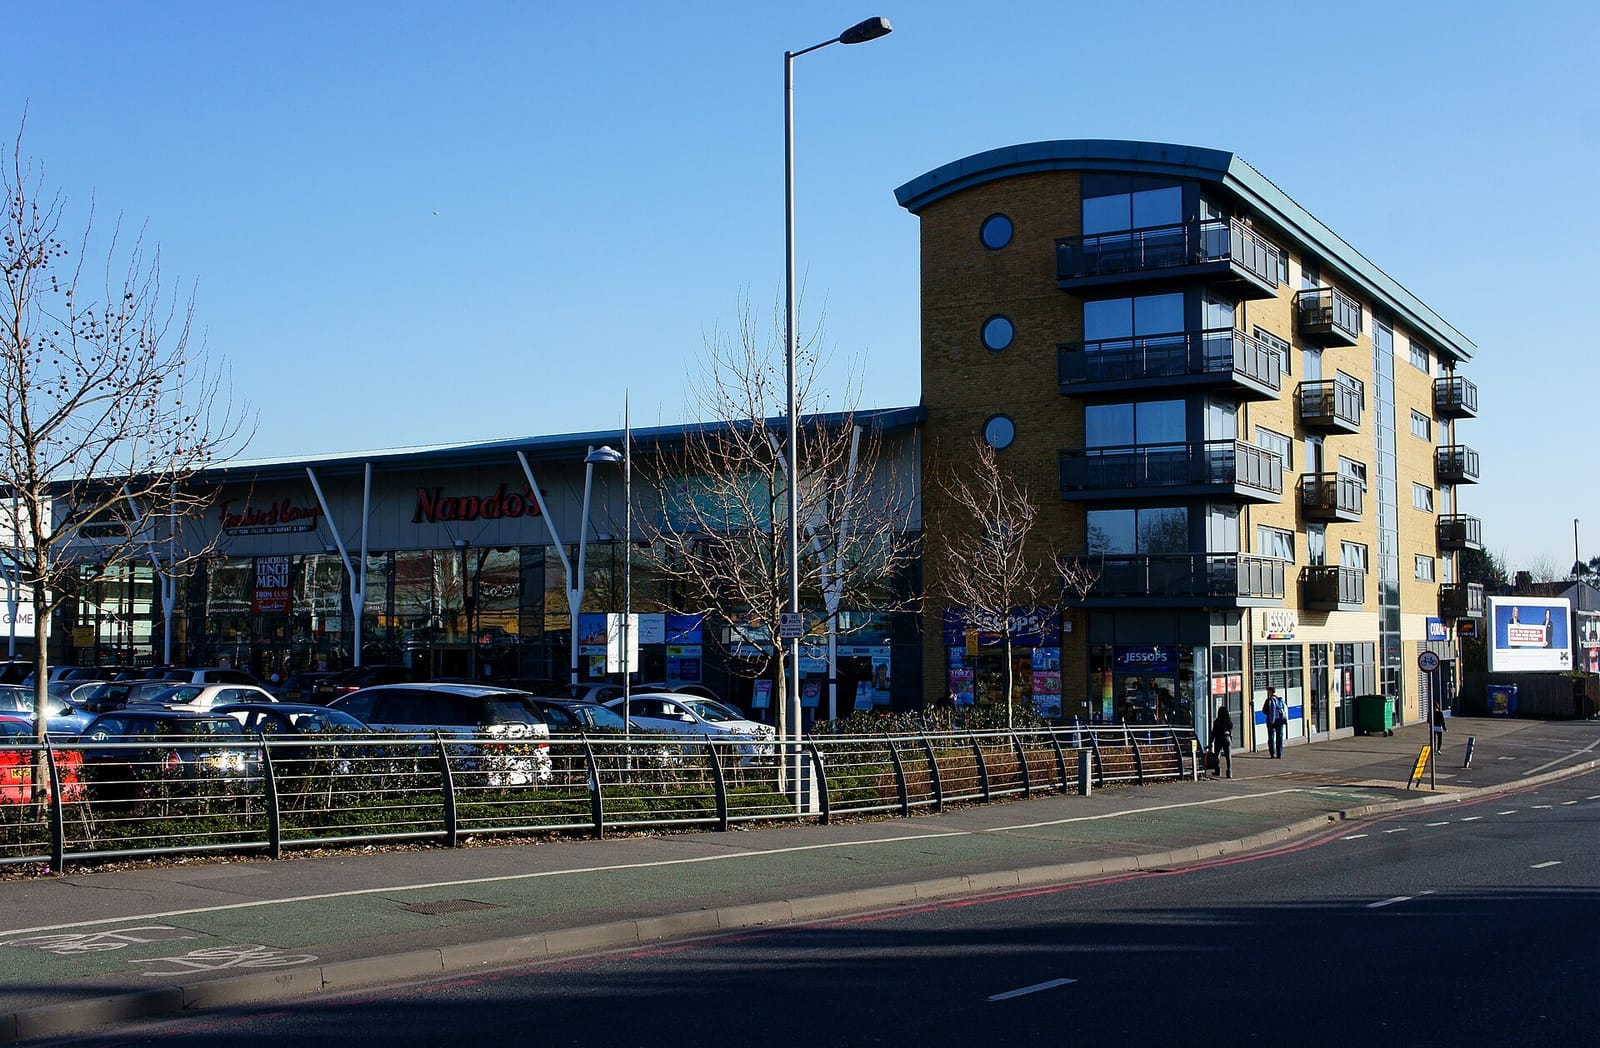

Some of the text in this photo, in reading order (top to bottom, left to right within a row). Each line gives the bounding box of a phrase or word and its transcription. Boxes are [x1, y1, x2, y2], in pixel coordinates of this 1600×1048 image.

[412, 483, 545, 523] Nando's
[256, 556, 289, 565] DELICIOUS
[256, 563, 288, 575] LUNCH
[256, 575, 289, 588] MENU
[3, 613, 33, 624] GME
[1123, 651, 1168, 664] JESSOPS
